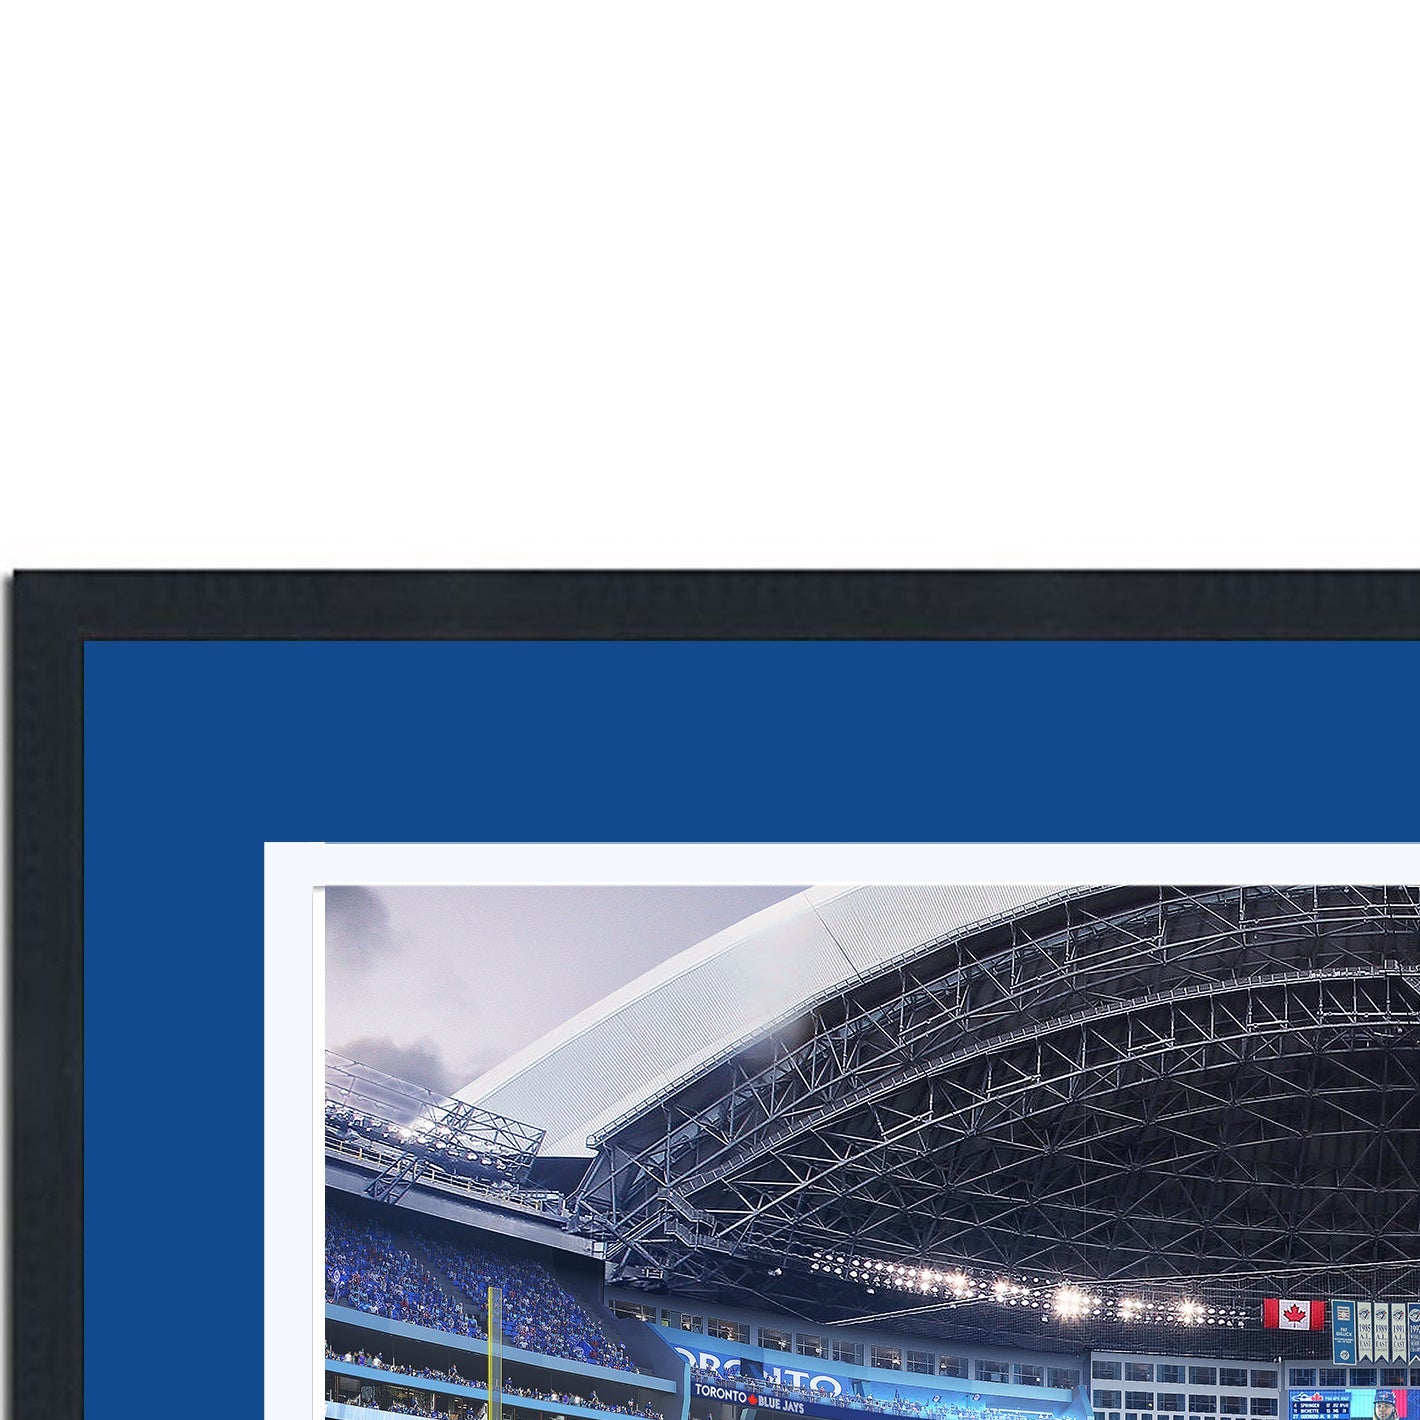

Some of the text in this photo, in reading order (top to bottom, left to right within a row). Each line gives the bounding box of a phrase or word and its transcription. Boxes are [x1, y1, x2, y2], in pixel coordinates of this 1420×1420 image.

[1360, 1324, 1370, 1332] 1985
[1376, 1324, 1387, 1332] 1989
[1393, 1325, 1404, 1333] 1991
[695, 1383, 804, 1414] TORONTO BLUE JAYS
